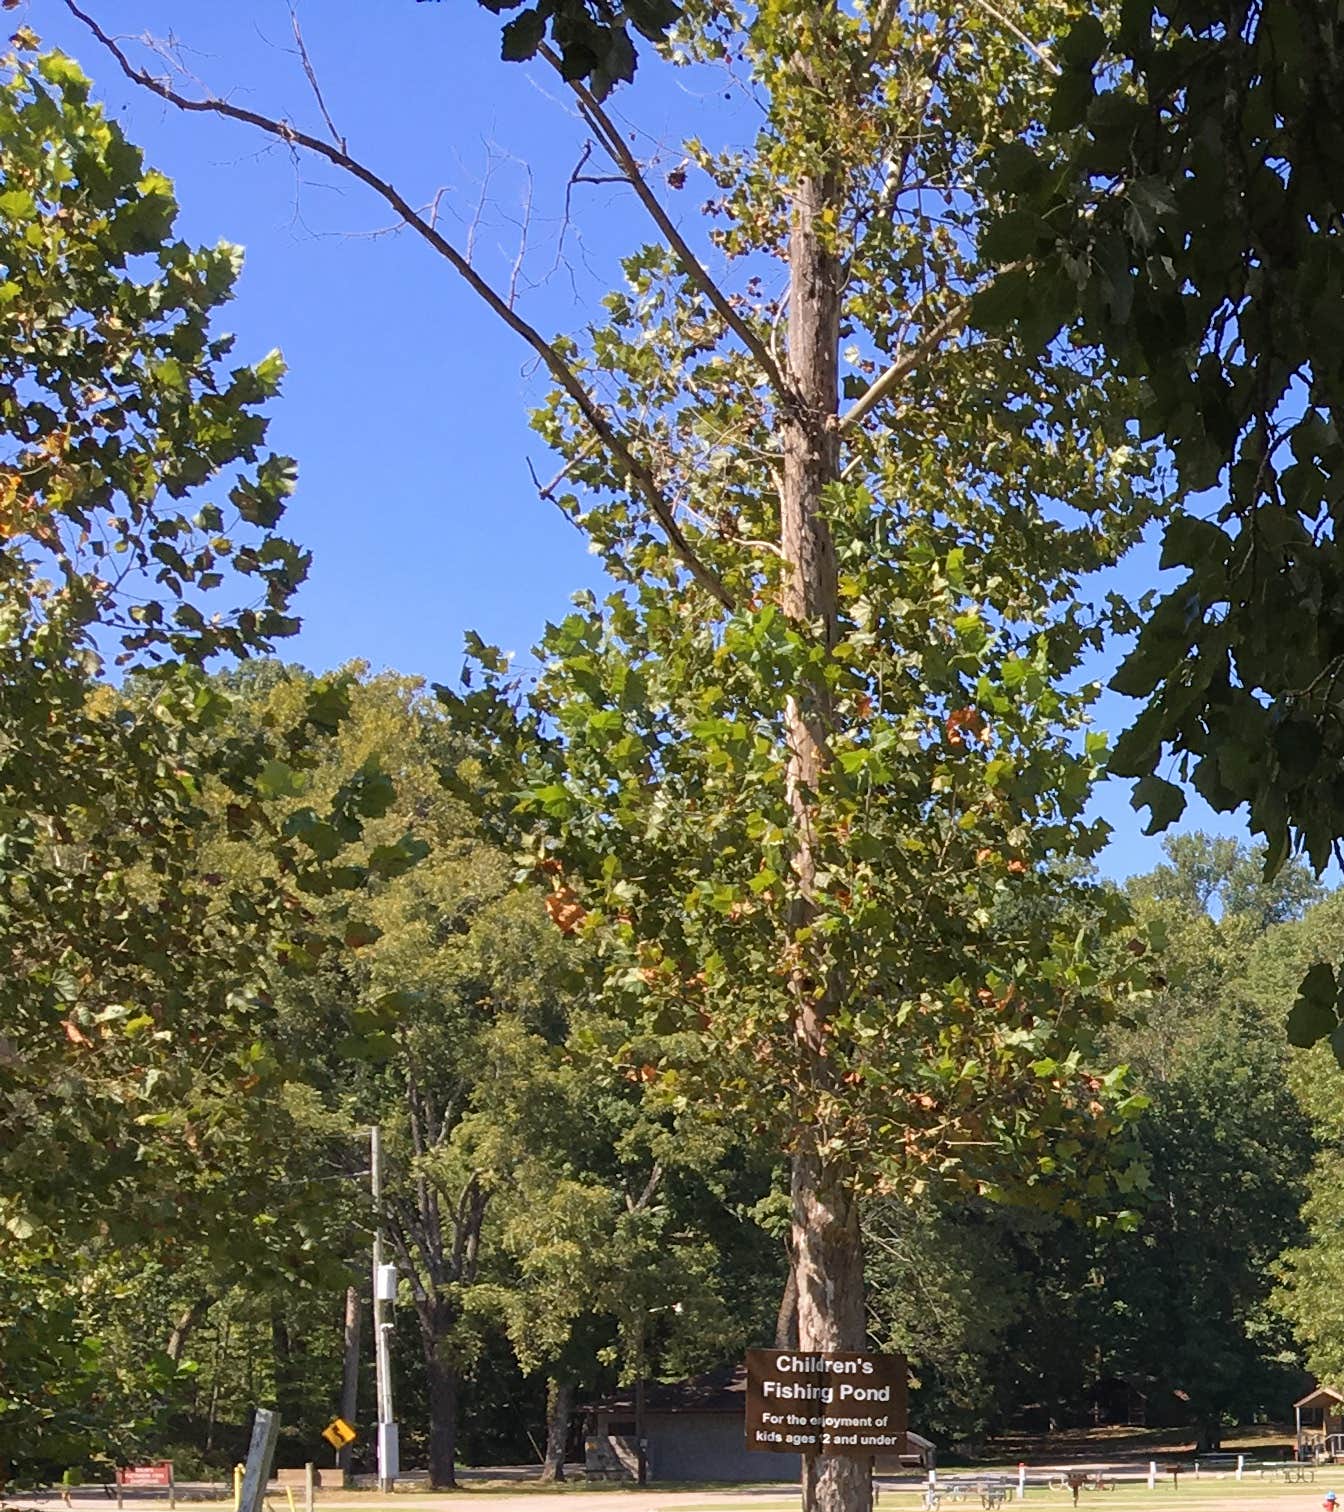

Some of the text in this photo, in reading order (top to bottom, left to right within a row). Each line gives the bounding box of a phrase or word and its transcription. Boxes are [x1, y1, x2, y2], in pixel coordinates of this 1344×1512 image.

[776, 1355, 874, 1374] Children's
[763, 1382, 890, 1403] Fishing Pond
[762, 1413, 784, 1425] For
[786, 1414, 807, 1426] the
[875, 1416, 888, 1427] of
[755, 1430, 783, 1442] kids
[786, 1434, 816, 1446] ages
[833, 1434, 857, 1445] and
[861, 1434, 898, 1446] under
